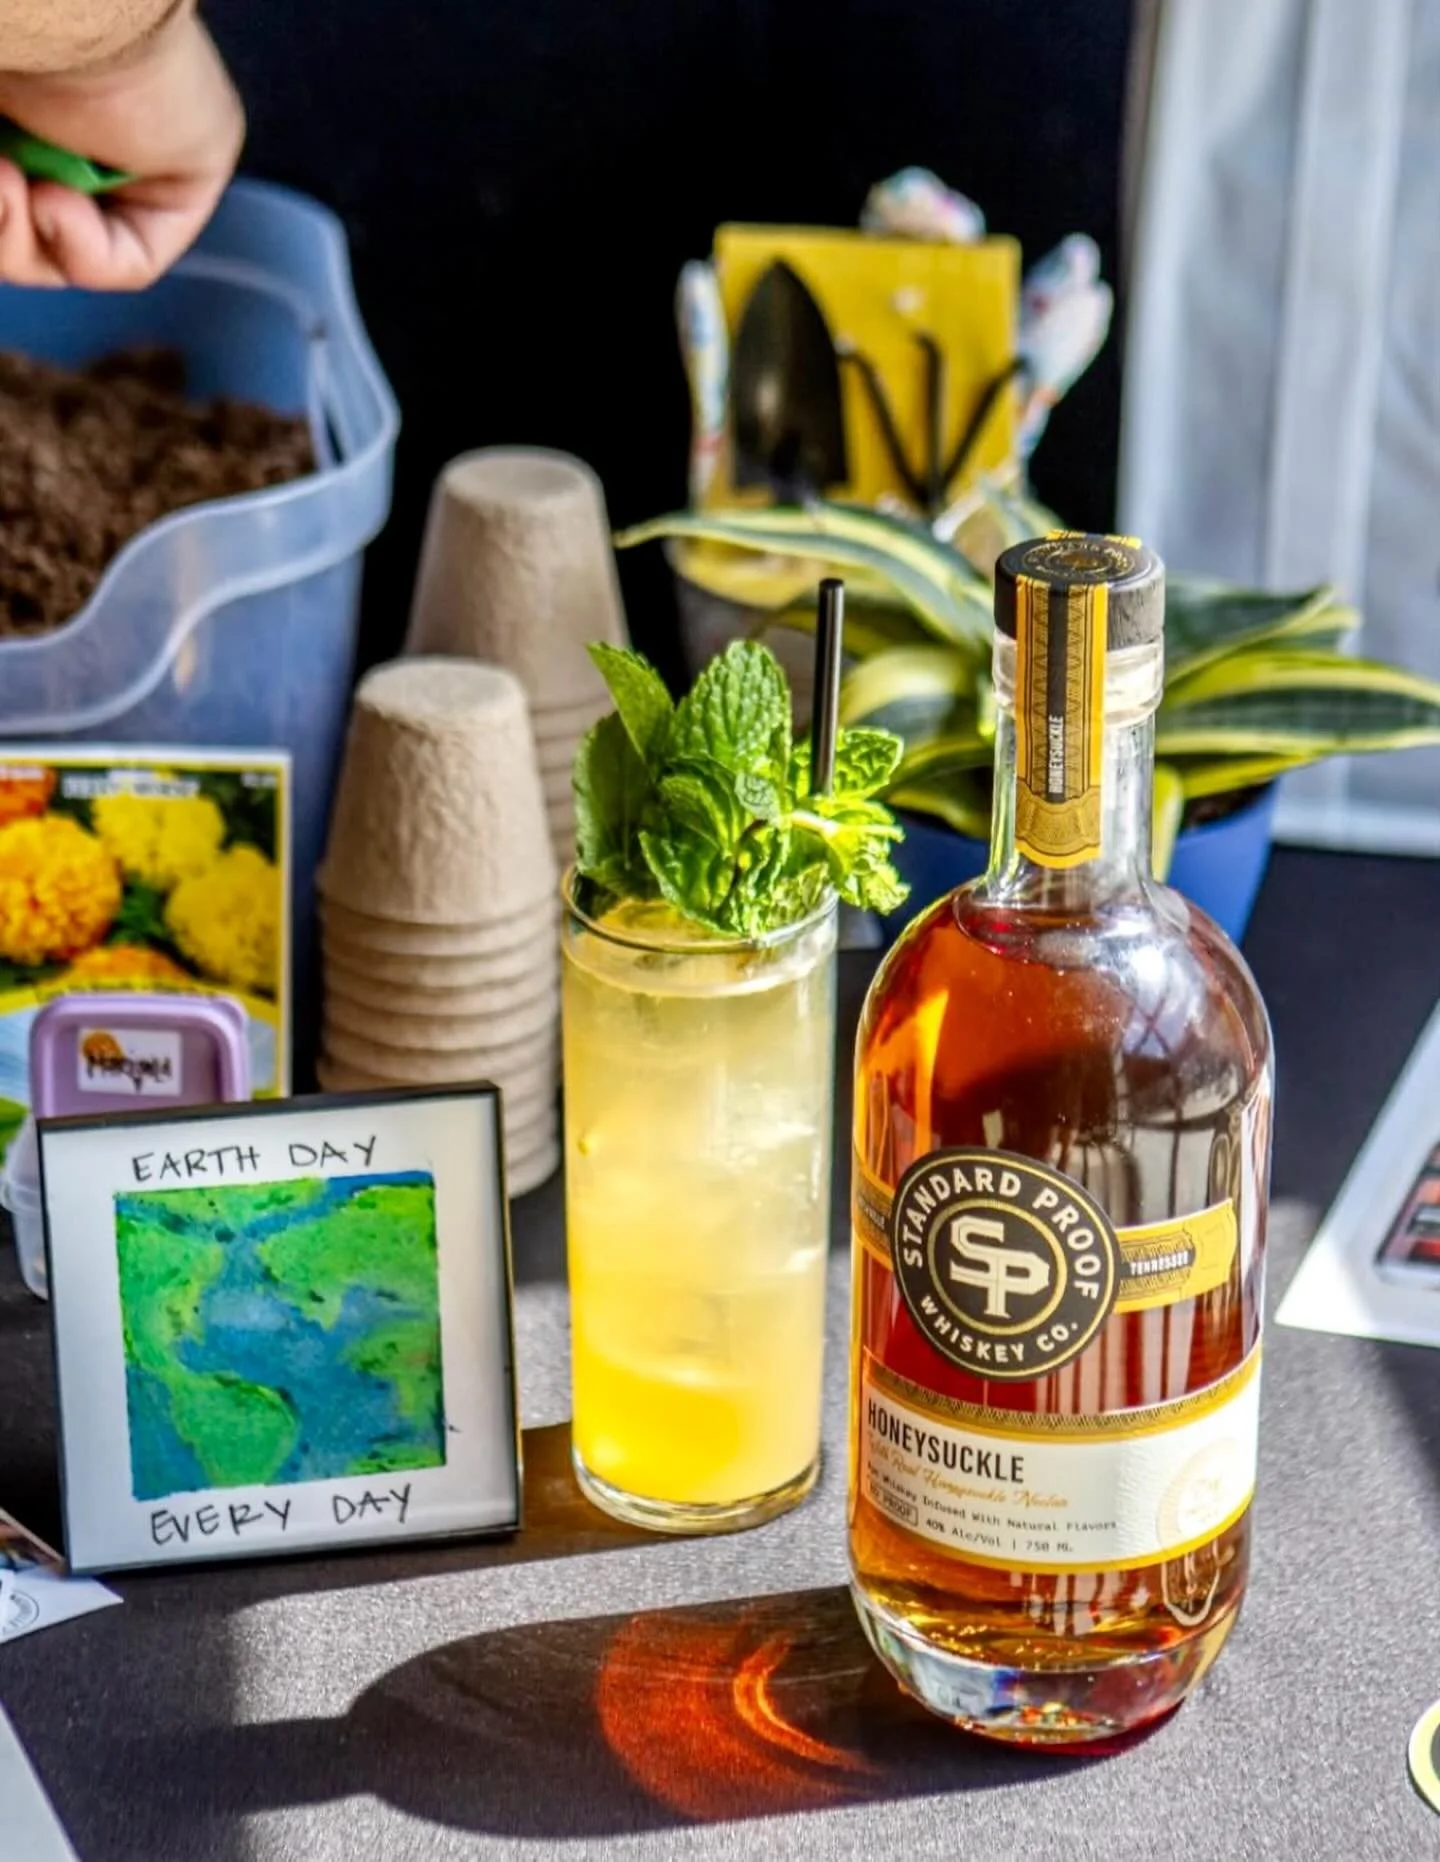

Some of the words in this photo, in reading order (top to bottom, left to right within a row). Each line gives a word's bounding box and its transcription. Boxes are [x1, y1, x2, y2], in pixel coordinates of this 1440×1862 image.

[1048, 714, 1064, 794] HONEYSUCKLE
[132, 1145, 261, 1182] EARTH
[288, 1135, 376, 1168] DAY
[903, 1167, 1022, 1270] STANDARD
[1032, 1187, 1101, 1300] PROOF
[1129, 1249, 1189, 1277] TENNESSEE
[920, 1295, 1025, 1363] WHISKEY
[1036, 1321, 1079, 1352] CO.
[867, 1396, 1025, 1484] HONEYSUCKLE
[151, 1499, 292, 1546] EVERY
[332, 1483, 412, 1526] DAY
[922, 1494, 966, 1519] Infused
[1007, 1517, 1058, 1532] Natural
[1066, 1521, 1118, 1533] Flavors
[925, 1518, 946, 1534] 40%
[951, 1526, 1001, 1549] Alc/Vol
[1026, 1540, 1050, 1553] 750
